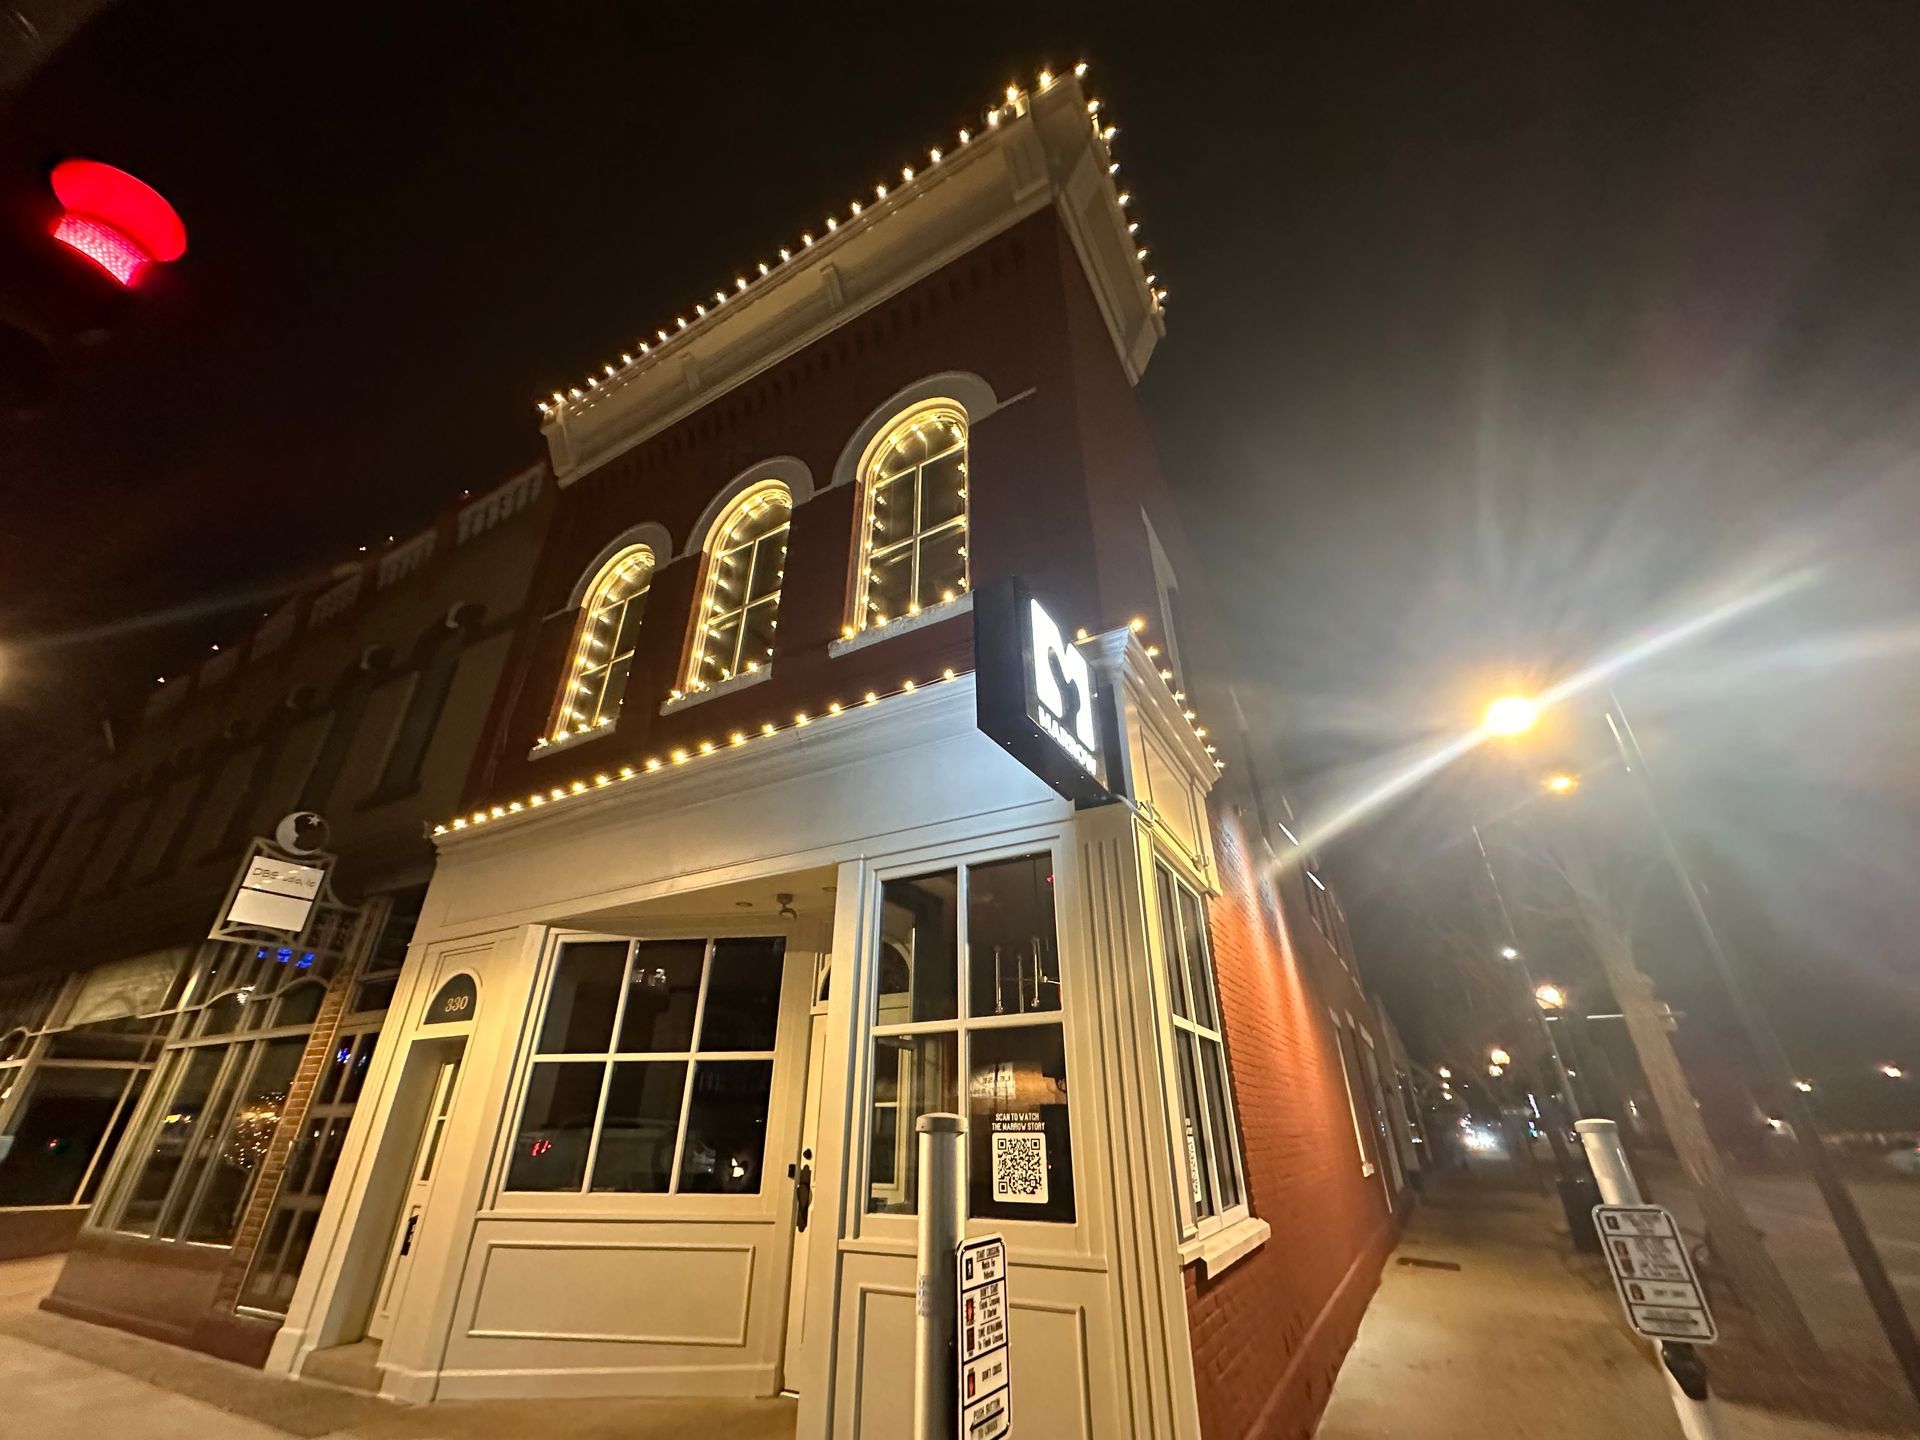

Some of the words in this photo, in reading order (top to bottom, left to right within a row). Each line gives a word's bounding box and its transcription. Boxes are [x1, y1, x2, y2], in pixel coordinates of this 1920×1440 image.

[1038, 704, 1097, 776] MARROW
[445, 995, 469, 1012] 330
[995, 1112, 1010, 1121] SCAN
[1011, 1112, 1018, 1121] TO
[1019, 1112, 1040, 1121] WATCH
[992, 1122, 1002, 1131] THE
[1002, 1122, 1026, 1131] MARROW
[1027, 1122, 1046, 1131] STORY
